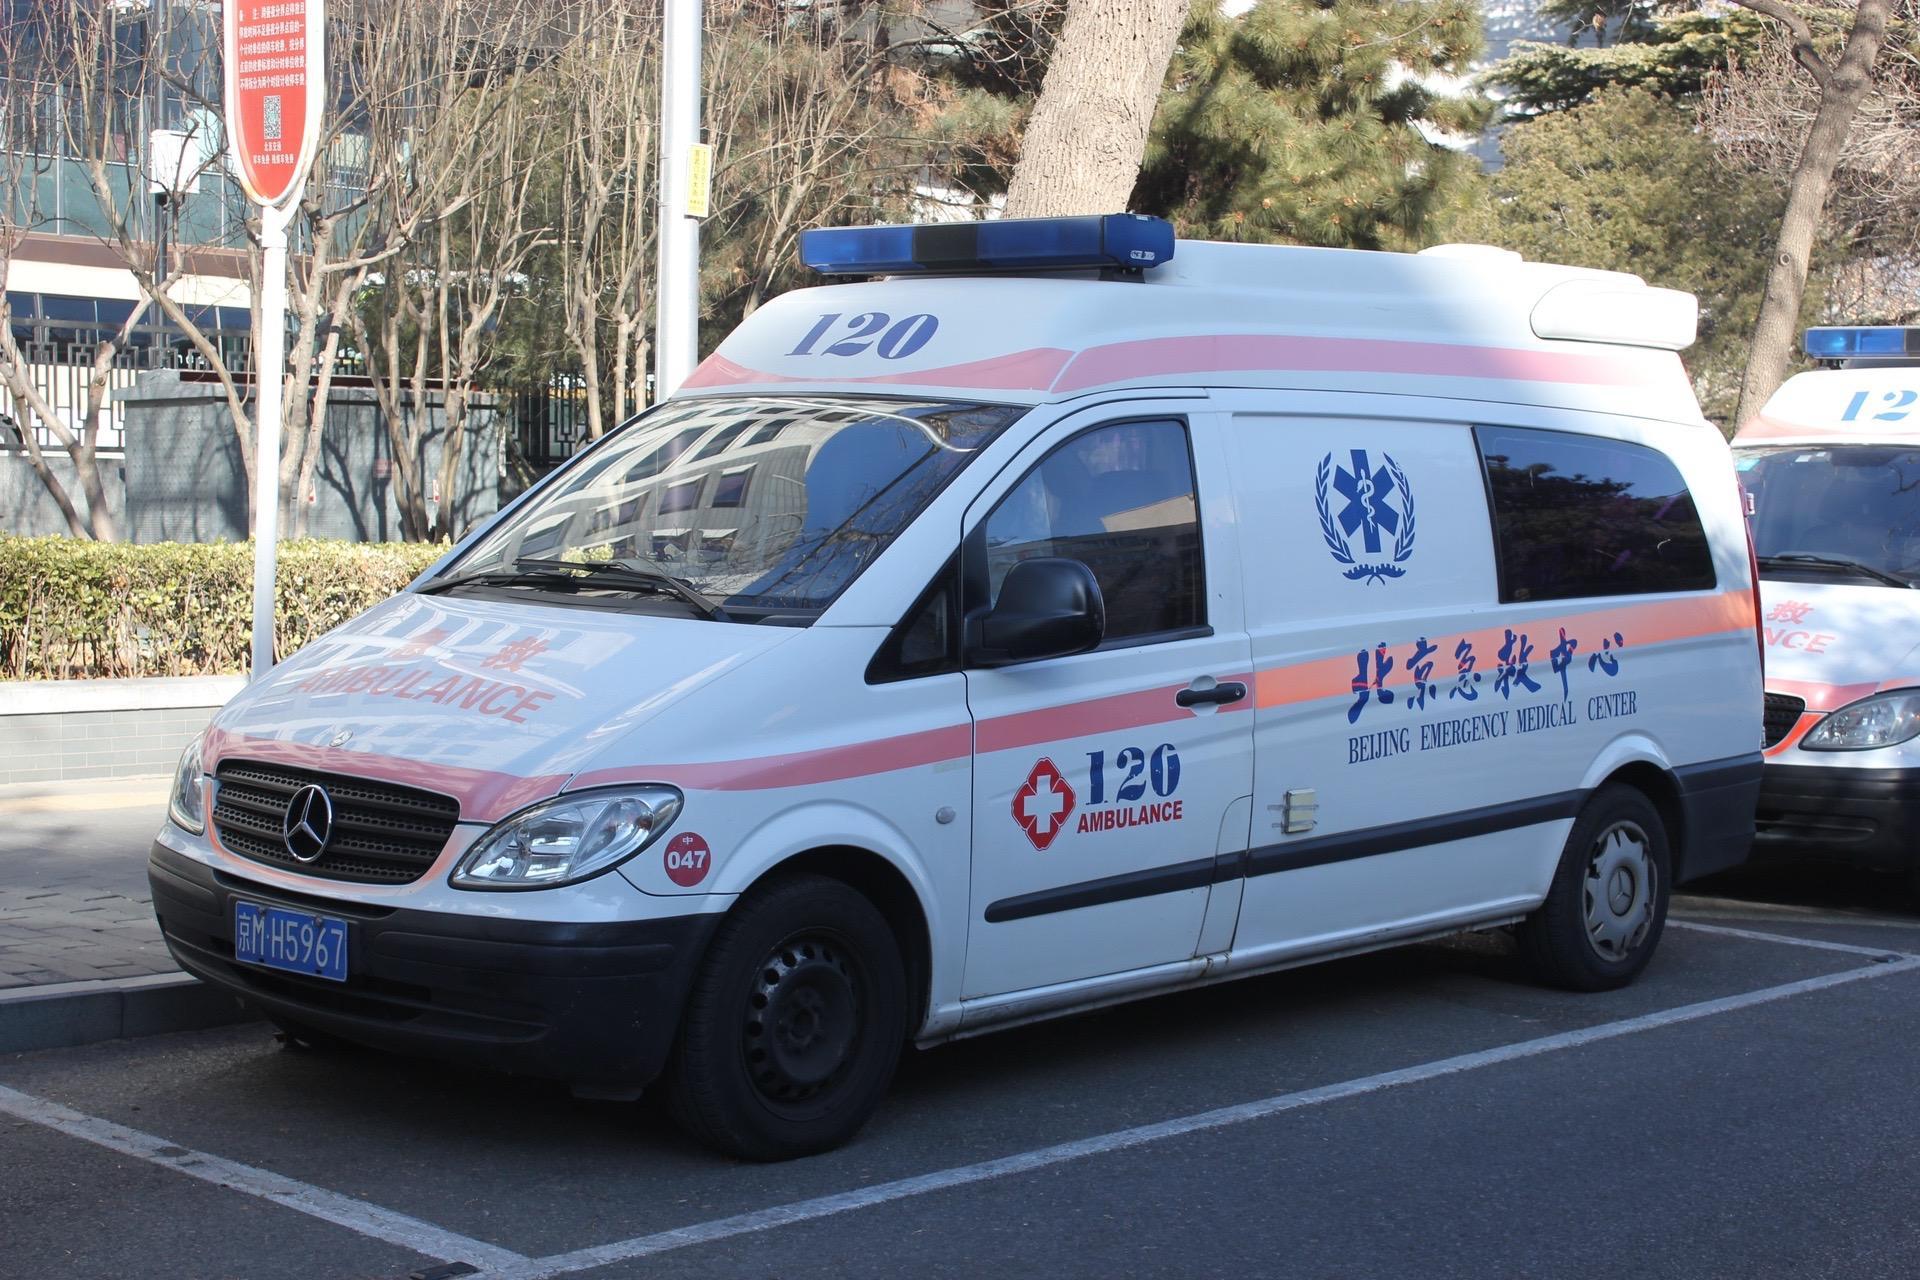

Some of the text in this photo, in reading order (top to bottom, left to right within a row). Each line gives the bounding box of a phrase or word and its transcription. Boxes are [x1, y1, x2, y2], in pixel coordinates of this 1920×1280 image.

[784, 312, 939, 360] 120
[290, 665, 556, 724] AMBULANCE
[1347, 626, 1624, 724] 北京急救中心
[1347, 690, 1638, 764] BEIJING EMERGENCY MEDICAL CENTER
[1085, 743, 1181, 806] 120
[682, 835, 693, 845] 中
[1076, 800, 1183, 834] AMBULANCE
[667, 850, 707, 870] 047
